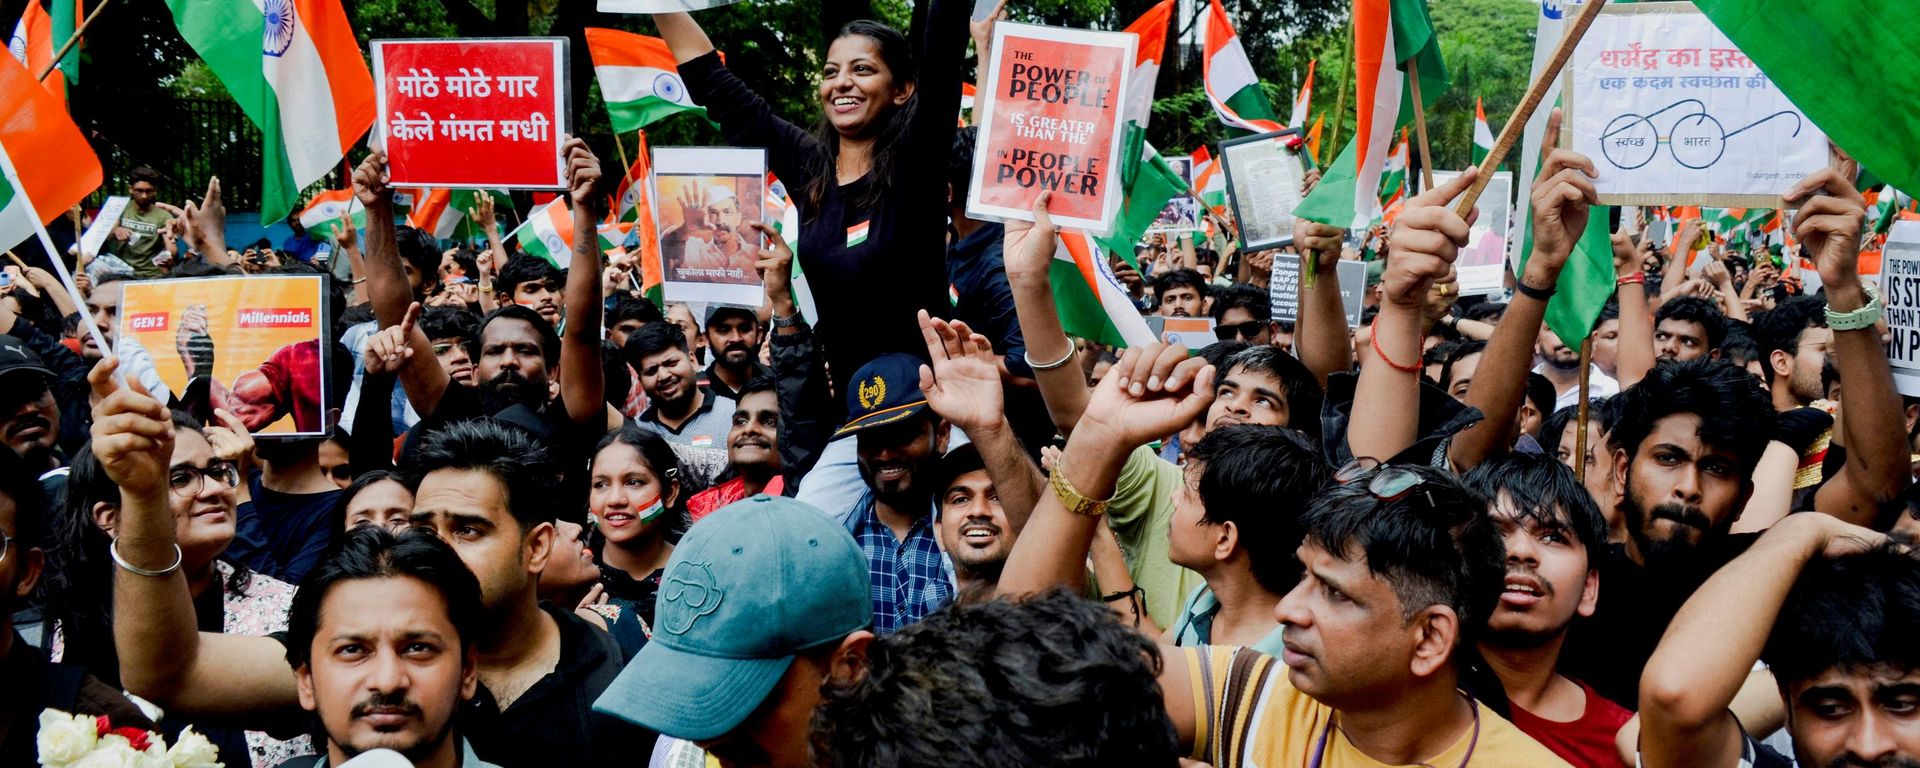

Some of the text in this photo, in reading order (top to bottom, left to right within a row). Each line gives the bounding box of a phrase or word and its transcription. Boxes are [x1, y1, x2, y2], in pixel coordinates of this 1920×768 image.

[1014, 50, 1034, 61] THE
[1667, 48, 1702, 67] का
[397, 67, 539, 97] मोठे मोठे गार
[1012, 63, 1108, 86] POWER OF
[1600, 72, 1767, 89] एक कदम स्वच्छता की
[1009, 79, 1111, 109] PEOPLE
[391, 112, 550, 142] केले गंमत मधी
[1010, 113, 1095, 134] IS GREATER
[1015, 125, 1089, 145] THAN THE
[1615, 137, 1645, 147] स्वच्छ
[1684, 136, 1711, 147] भारत
[997, 148, 1100, 176] IN PEOPLE
[996, 163, 1099, 197] POWER
[1889, 258, 1920, 275] THE POW
[1888, 276, 1900, 306] IS
[132, 316, 165, 328] GEN Z
[239, 311, 311, 324] Millennials
[1887, 307, 1914, 328] THAN
[1887, 327, 1903, 360] IN
[864, 385, 879, 399] 290
